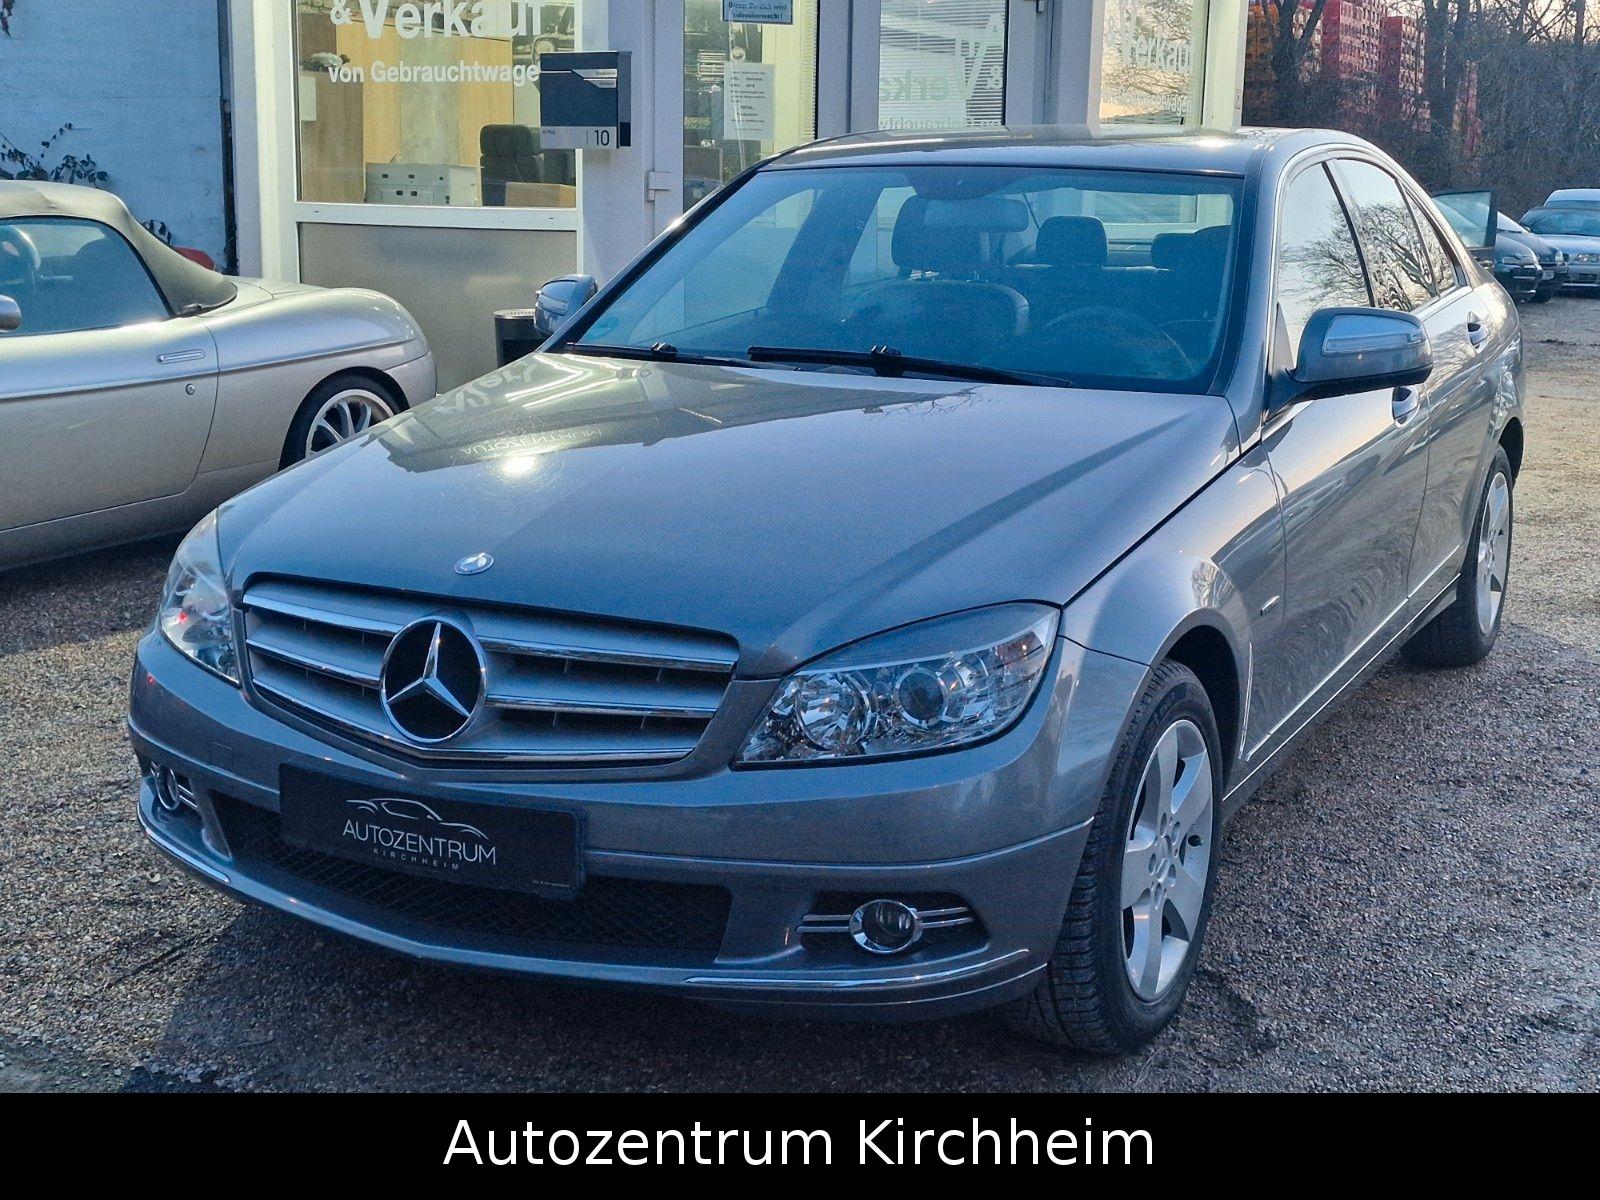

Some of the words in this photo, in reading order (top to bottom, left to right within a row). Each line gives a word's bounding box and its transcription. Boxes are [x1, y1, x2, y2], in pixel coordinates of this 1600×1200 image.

[330, 0, 352, 25] &
[357, 0, 546, 39] Verkauf
[328, 66, 364, 83] von
[371, 60, 540, 86] Gebrauchtwage
[594, 129, 610, 146] 10
[342, 818, 496, 866] AUTOZENTRUM
[373, 848, 460, 870] KIRCHHEIM
